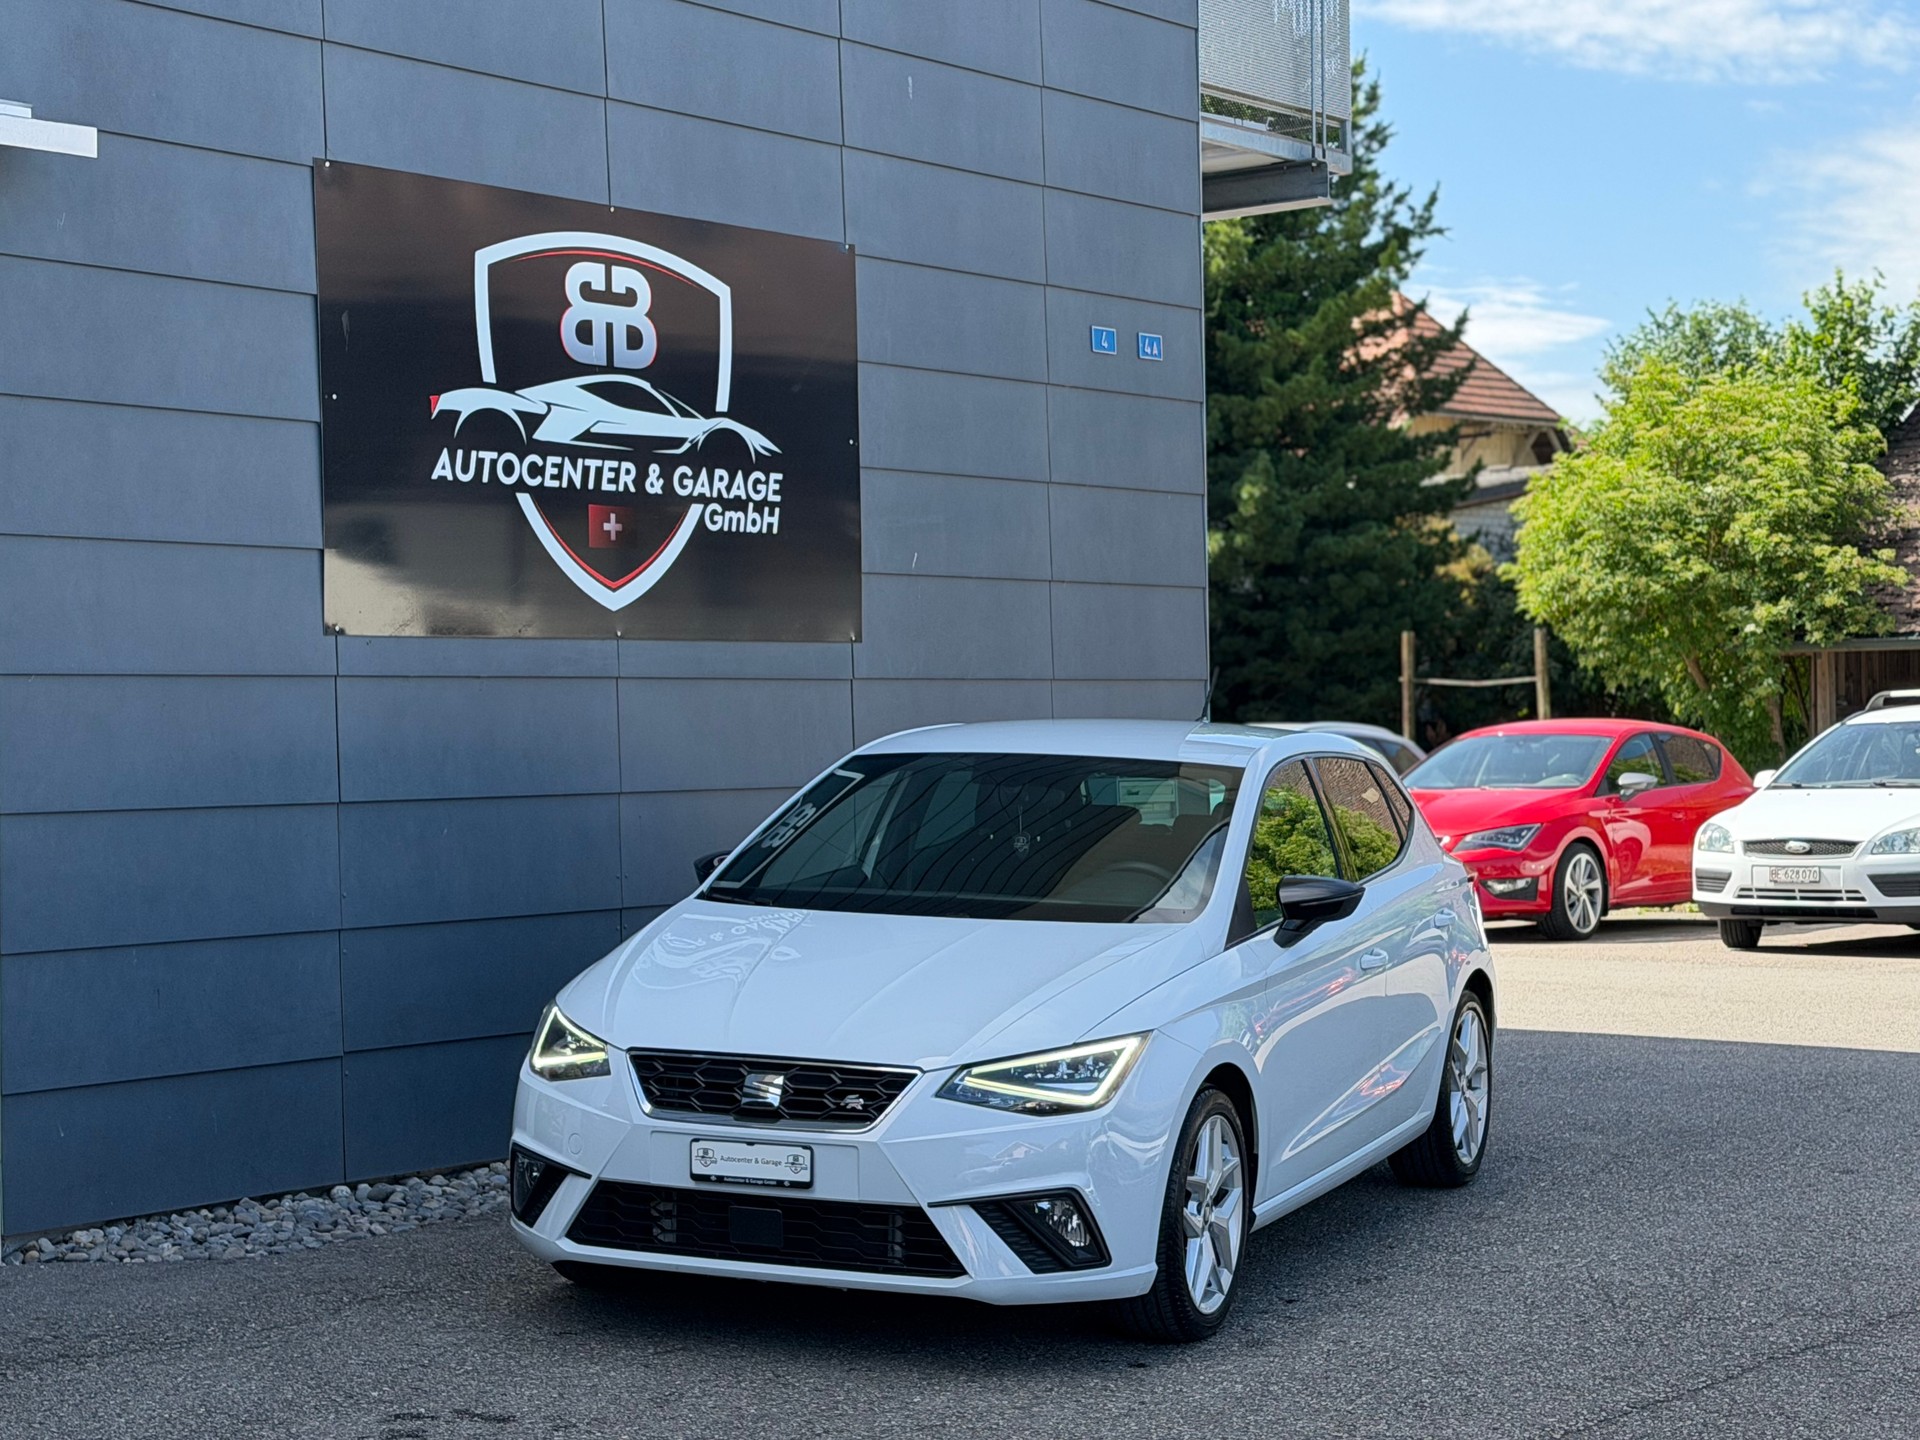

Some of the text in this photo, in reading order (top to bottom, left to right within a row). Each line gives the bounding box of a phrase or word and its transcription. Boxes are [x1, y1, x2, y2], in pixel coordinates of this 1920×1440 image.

[1101, 331, 1108, 349] 4
[1144, 337, 1158, 356] 4A
[431, 447, 784, 503] AUTOCENTER & GARAGE
[704, 502, 781, 535] GmbH
[1771, 868, 1782, 880] BE
[720, 1155, 753, 1165] Autocenter
[761, 1157, 782, 1168] Garage
